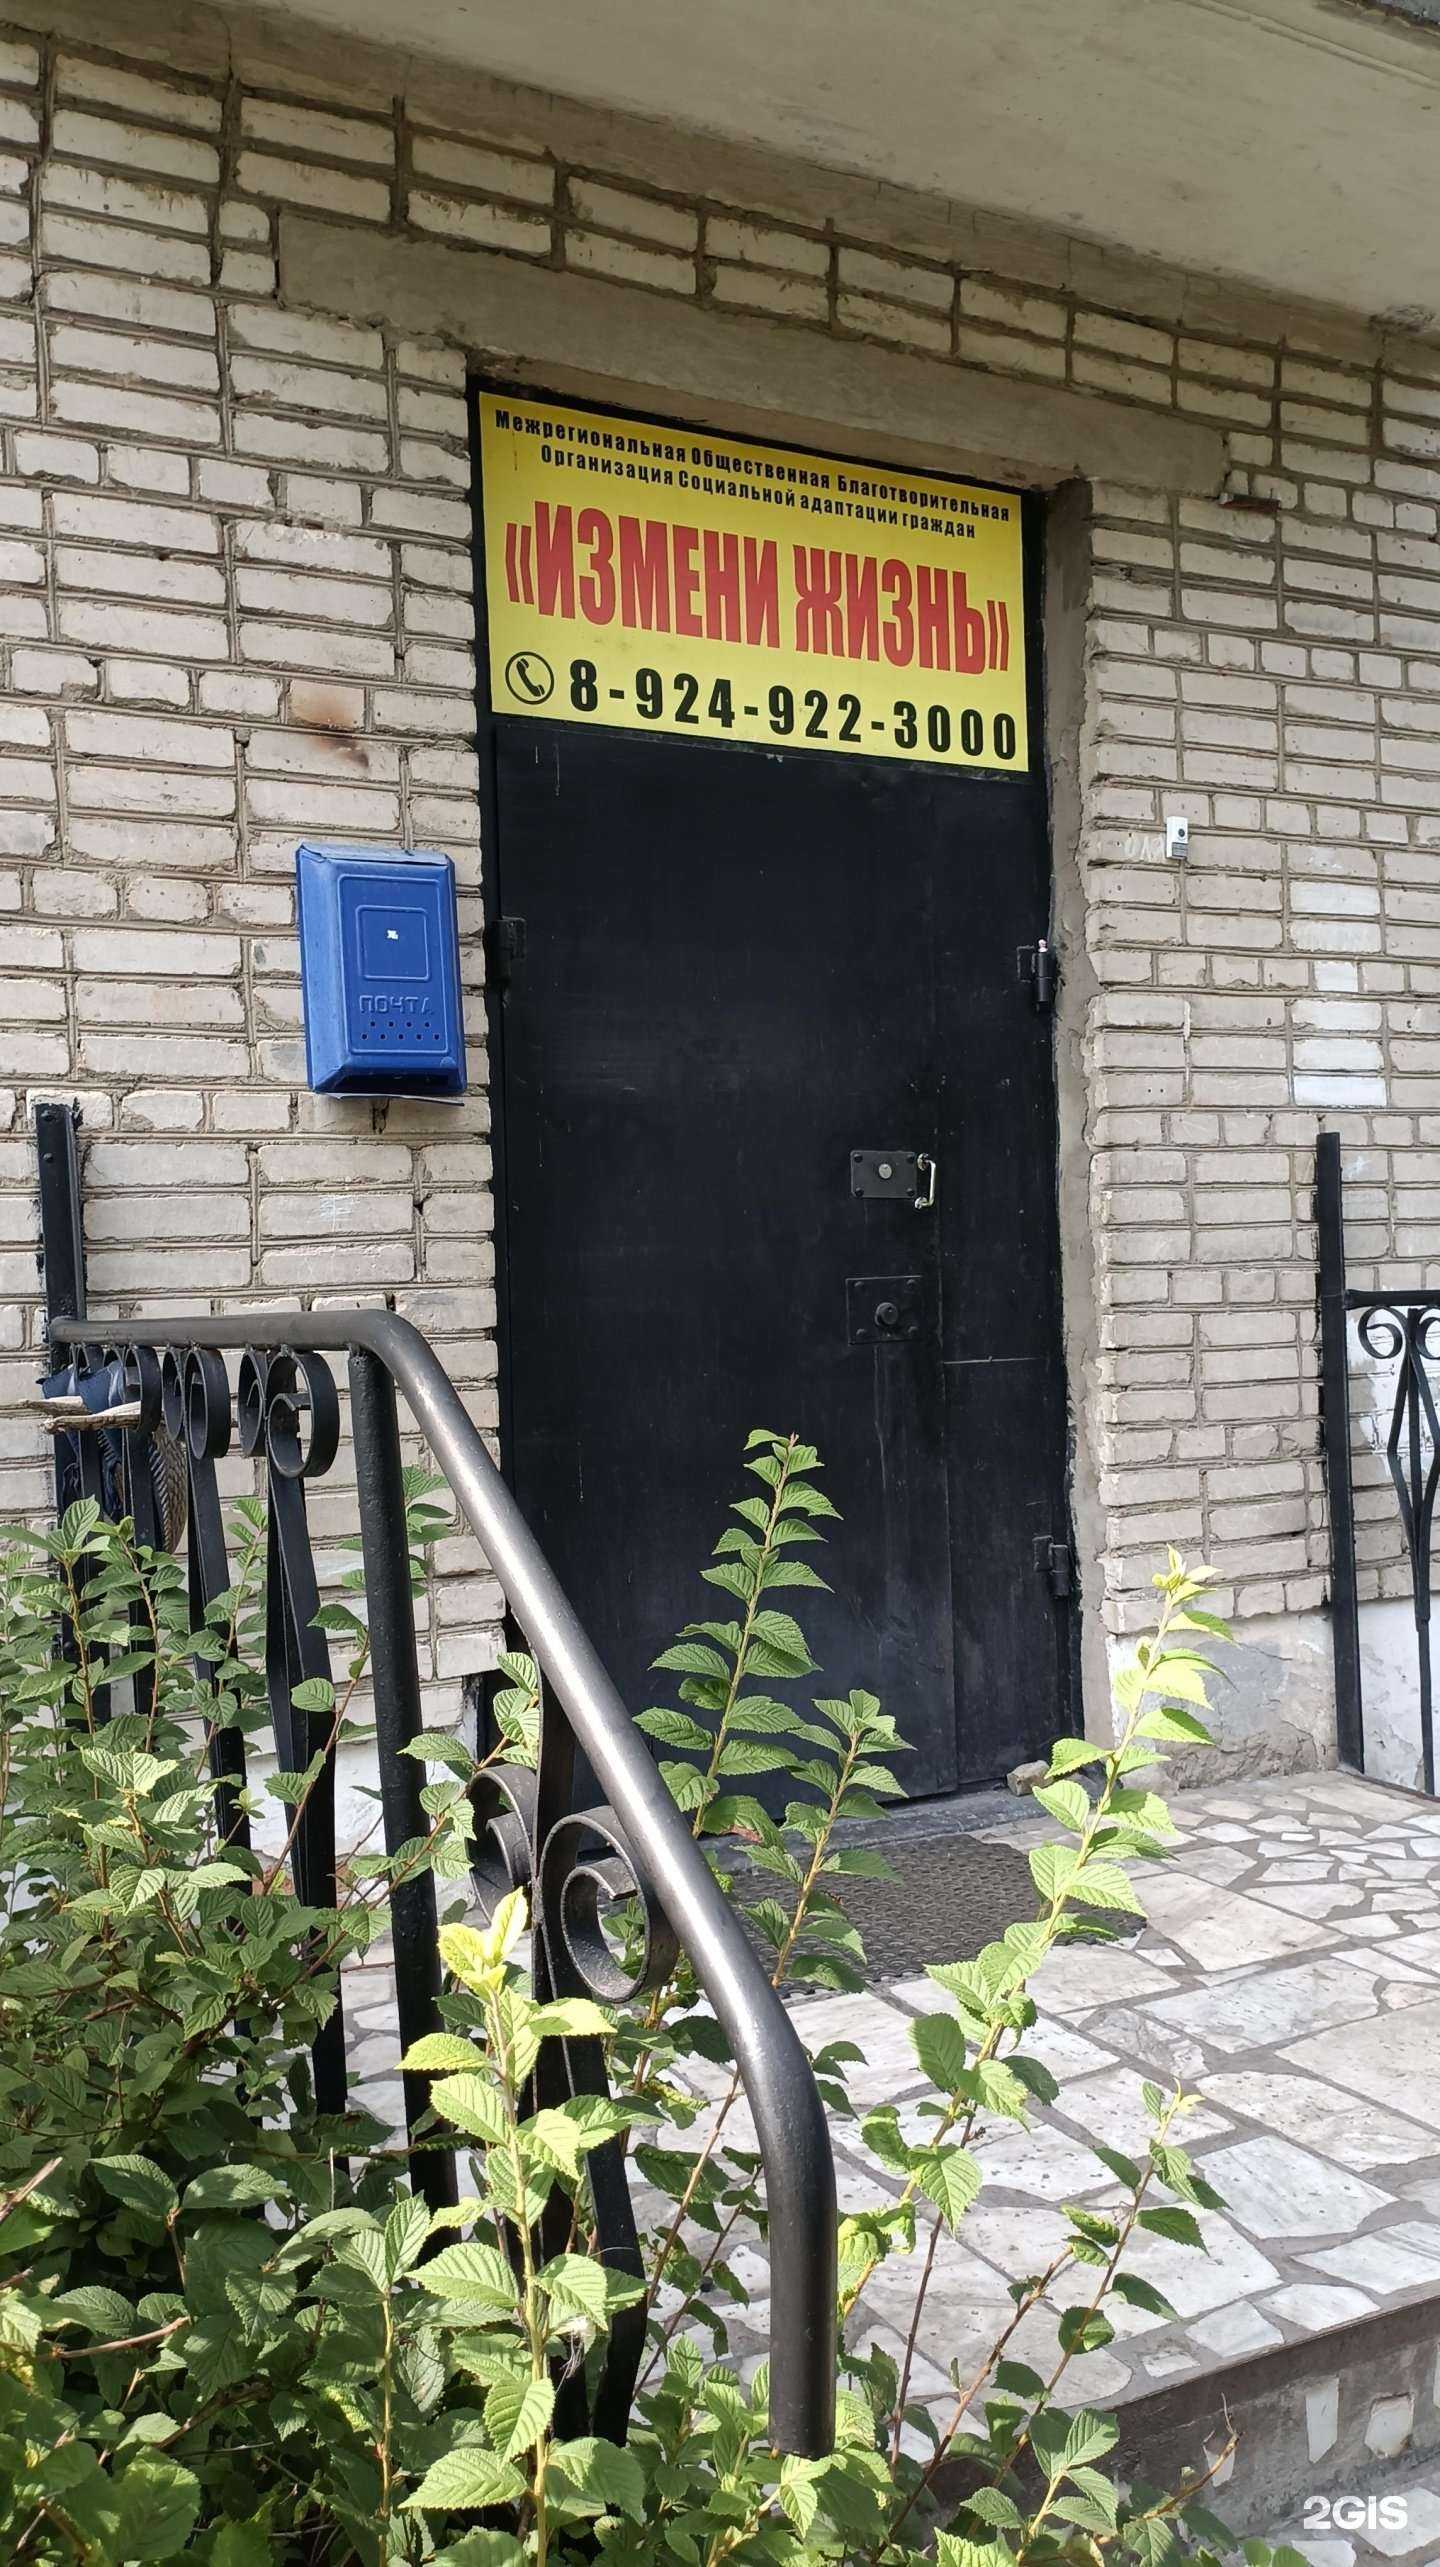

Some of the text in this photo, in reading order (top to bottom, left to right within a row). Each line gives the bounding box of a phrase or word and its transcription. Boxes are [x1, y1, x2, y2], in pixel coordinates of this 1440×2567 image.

[495, 409, 1010, 522] Межрегиональная Общественная Благотворительная
[540, 445, 976, 539] Организация Социальной адаптации граждан
[505, 500, 1009, 675] «ИЗМЕНИ ЖИЗНЬ»
[569, 659, 1017, 760] 8-924-922-3000
[359, 994, 435, 1016] ПОЧТА
